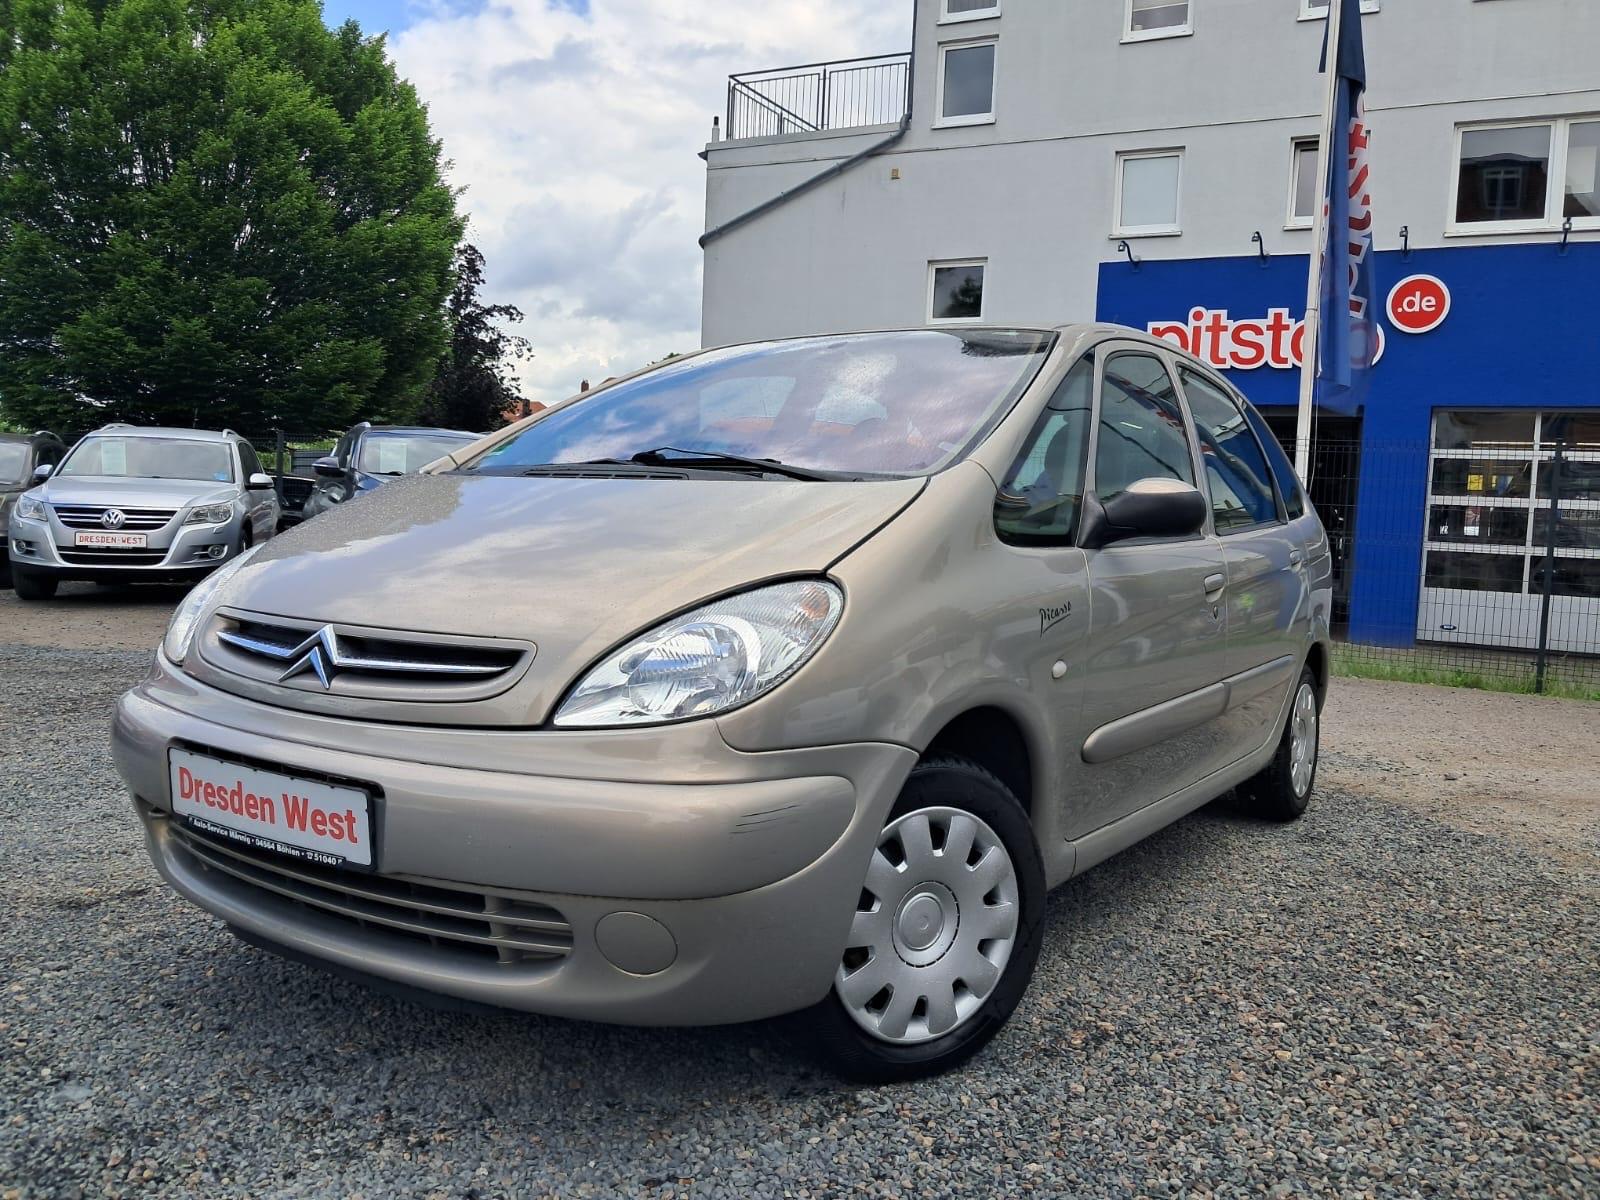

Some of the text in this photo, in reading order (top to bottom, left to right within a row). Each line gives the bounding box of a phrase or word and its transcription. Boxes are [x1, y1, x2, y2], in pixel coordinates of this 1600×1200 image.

[1397, 291, 1437, 313] .de
[79, 535, 144, 545] DRESDEN-WEST
[178, 766, 358, 844] Dresden West
[314, 853, 337, 865] 51040
